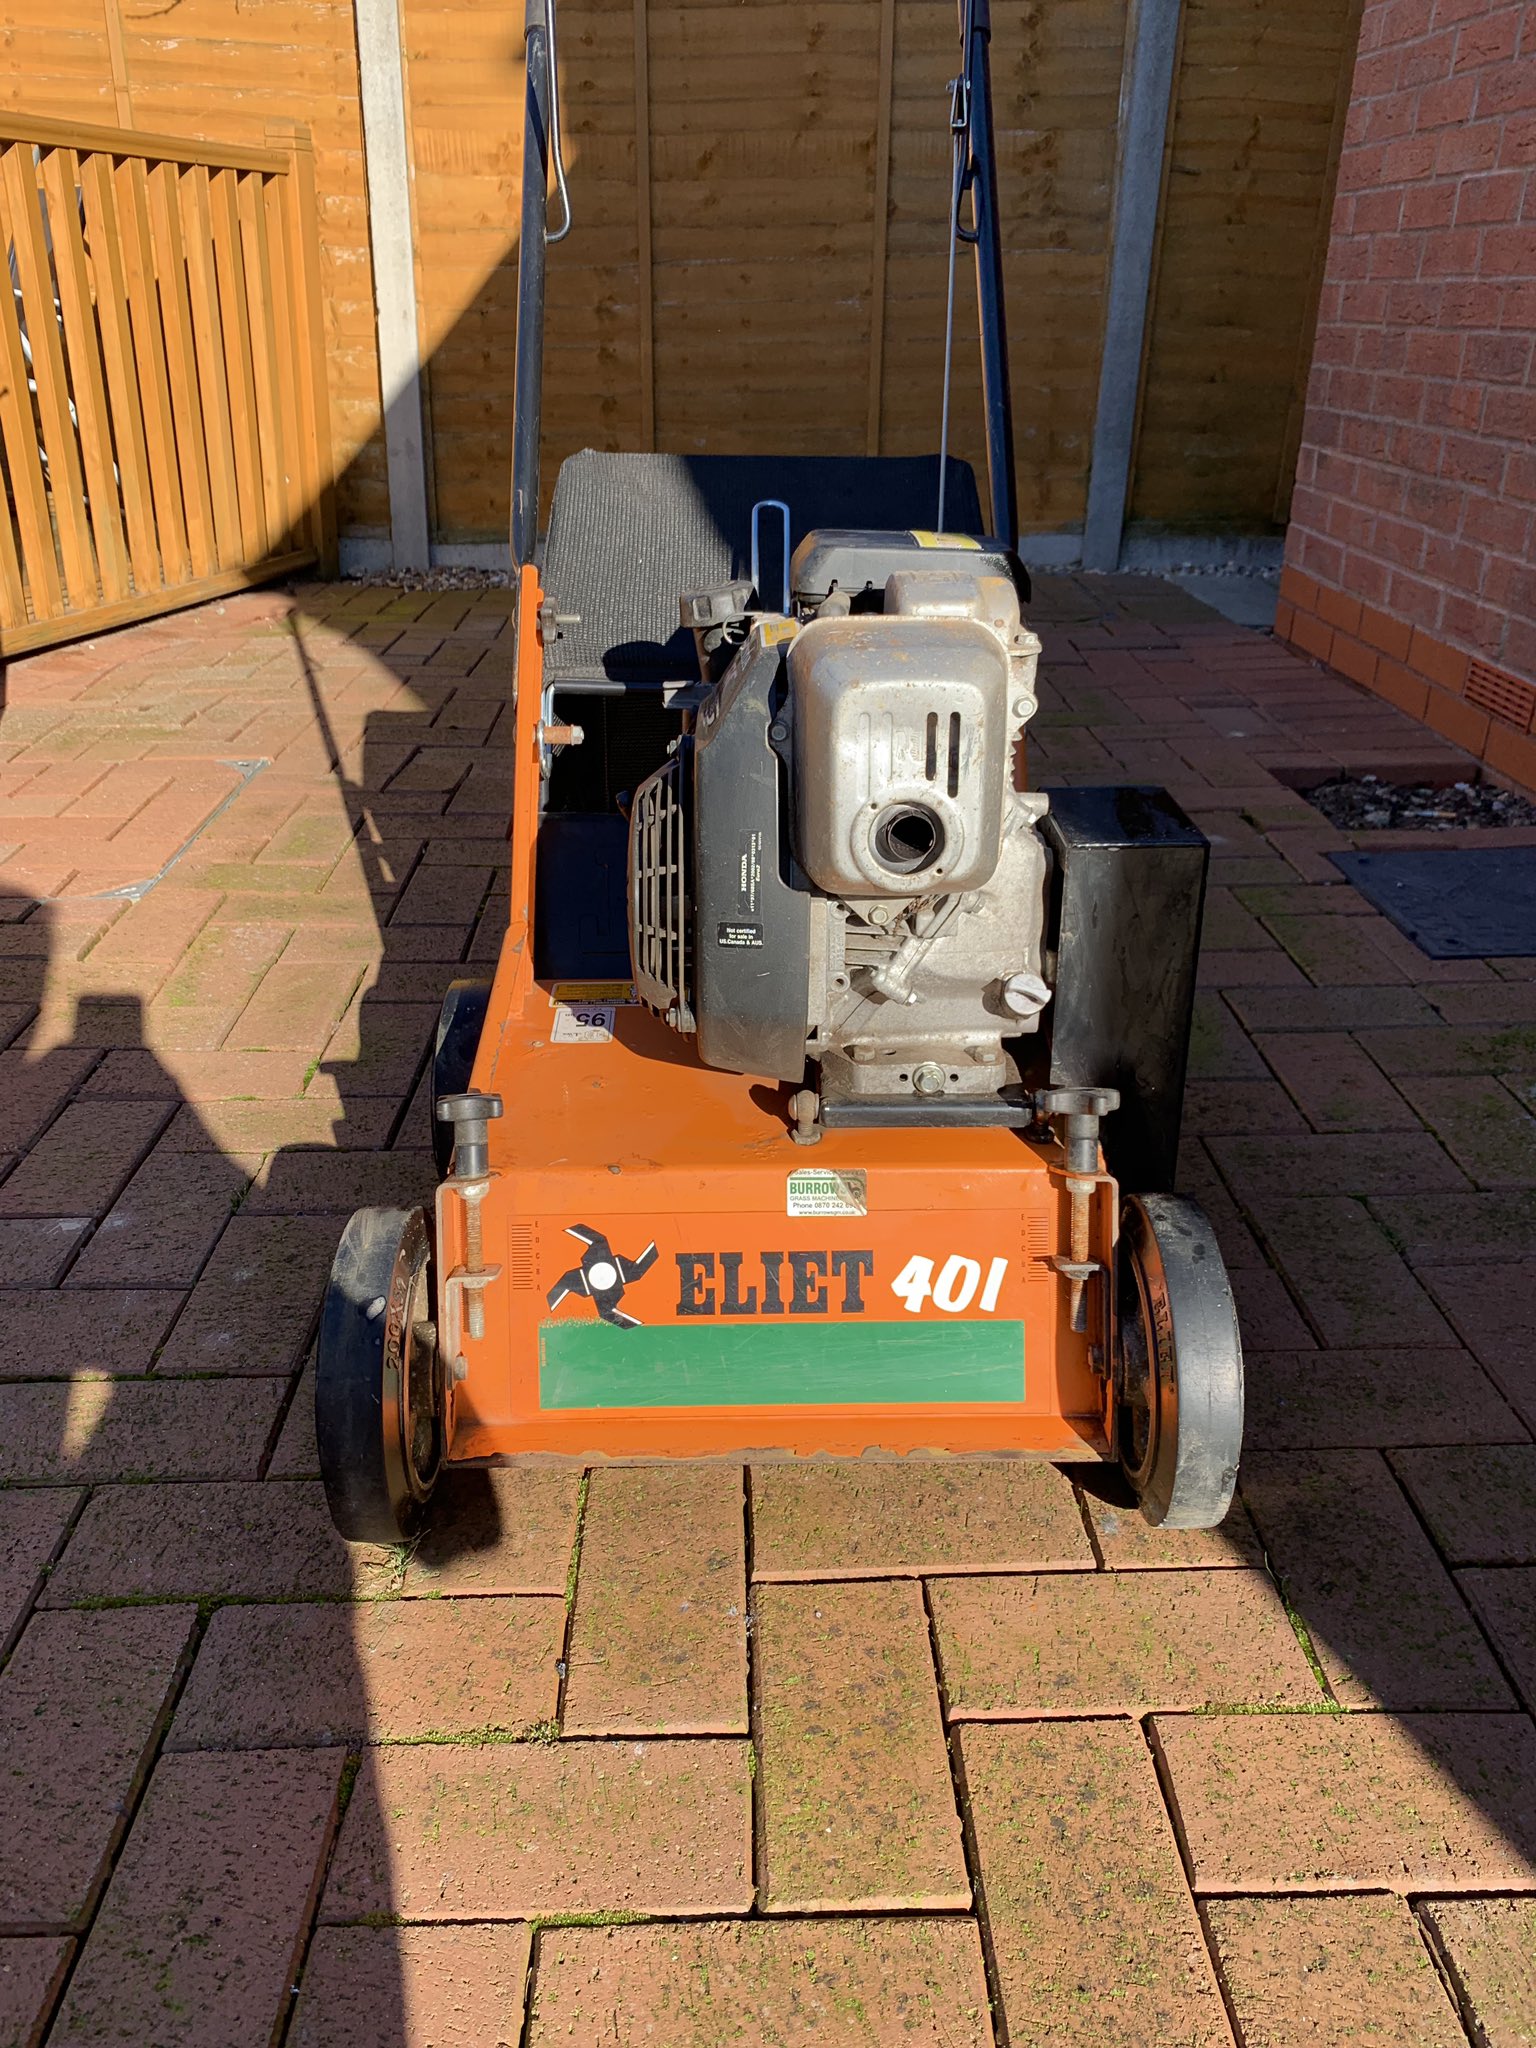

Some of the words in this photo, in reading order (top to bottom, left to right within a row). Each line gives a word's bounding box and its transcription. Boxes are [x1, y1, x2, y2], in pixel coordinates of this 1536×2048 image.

[576, 1013, 606, 1028] 95
[675, 1249, 874, 1317] ELIET
[890, 1254, 1009, 1313] 401
[1152, 1291, 1175, 1384] ELIET
